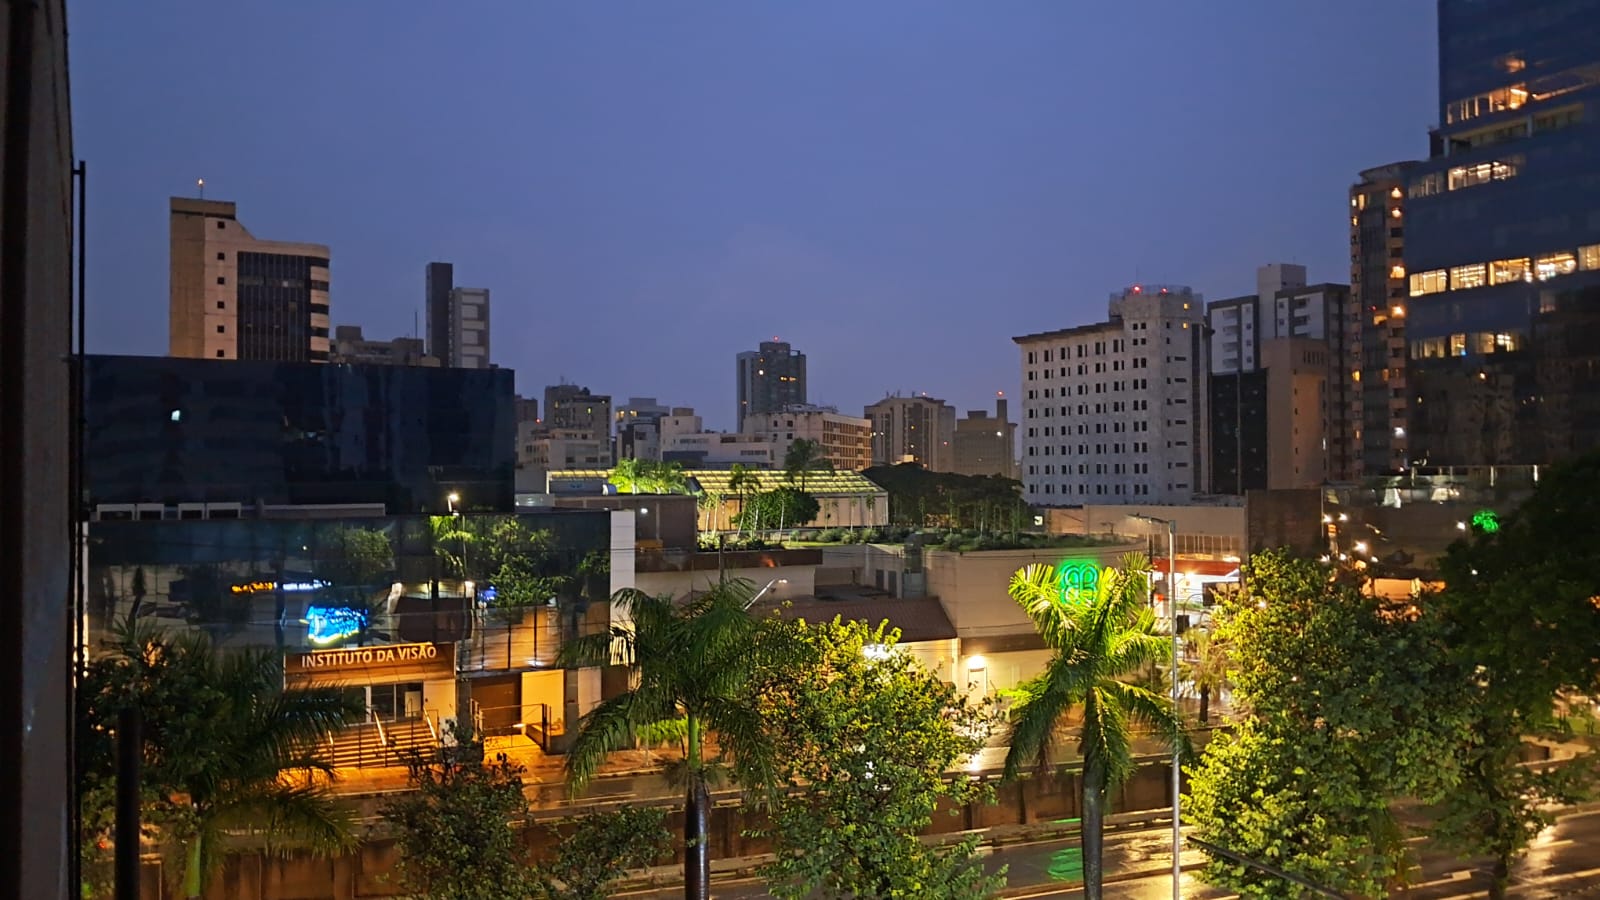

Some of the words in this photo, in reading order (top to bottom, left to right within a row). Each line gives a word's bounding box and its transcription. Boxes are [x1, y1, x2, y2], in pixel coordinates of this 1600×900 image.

[301, 651, 372, 668] INSTITUTO
[377, 650, 395, 663] DA
[397, 644, 436, 661] VISÃO
